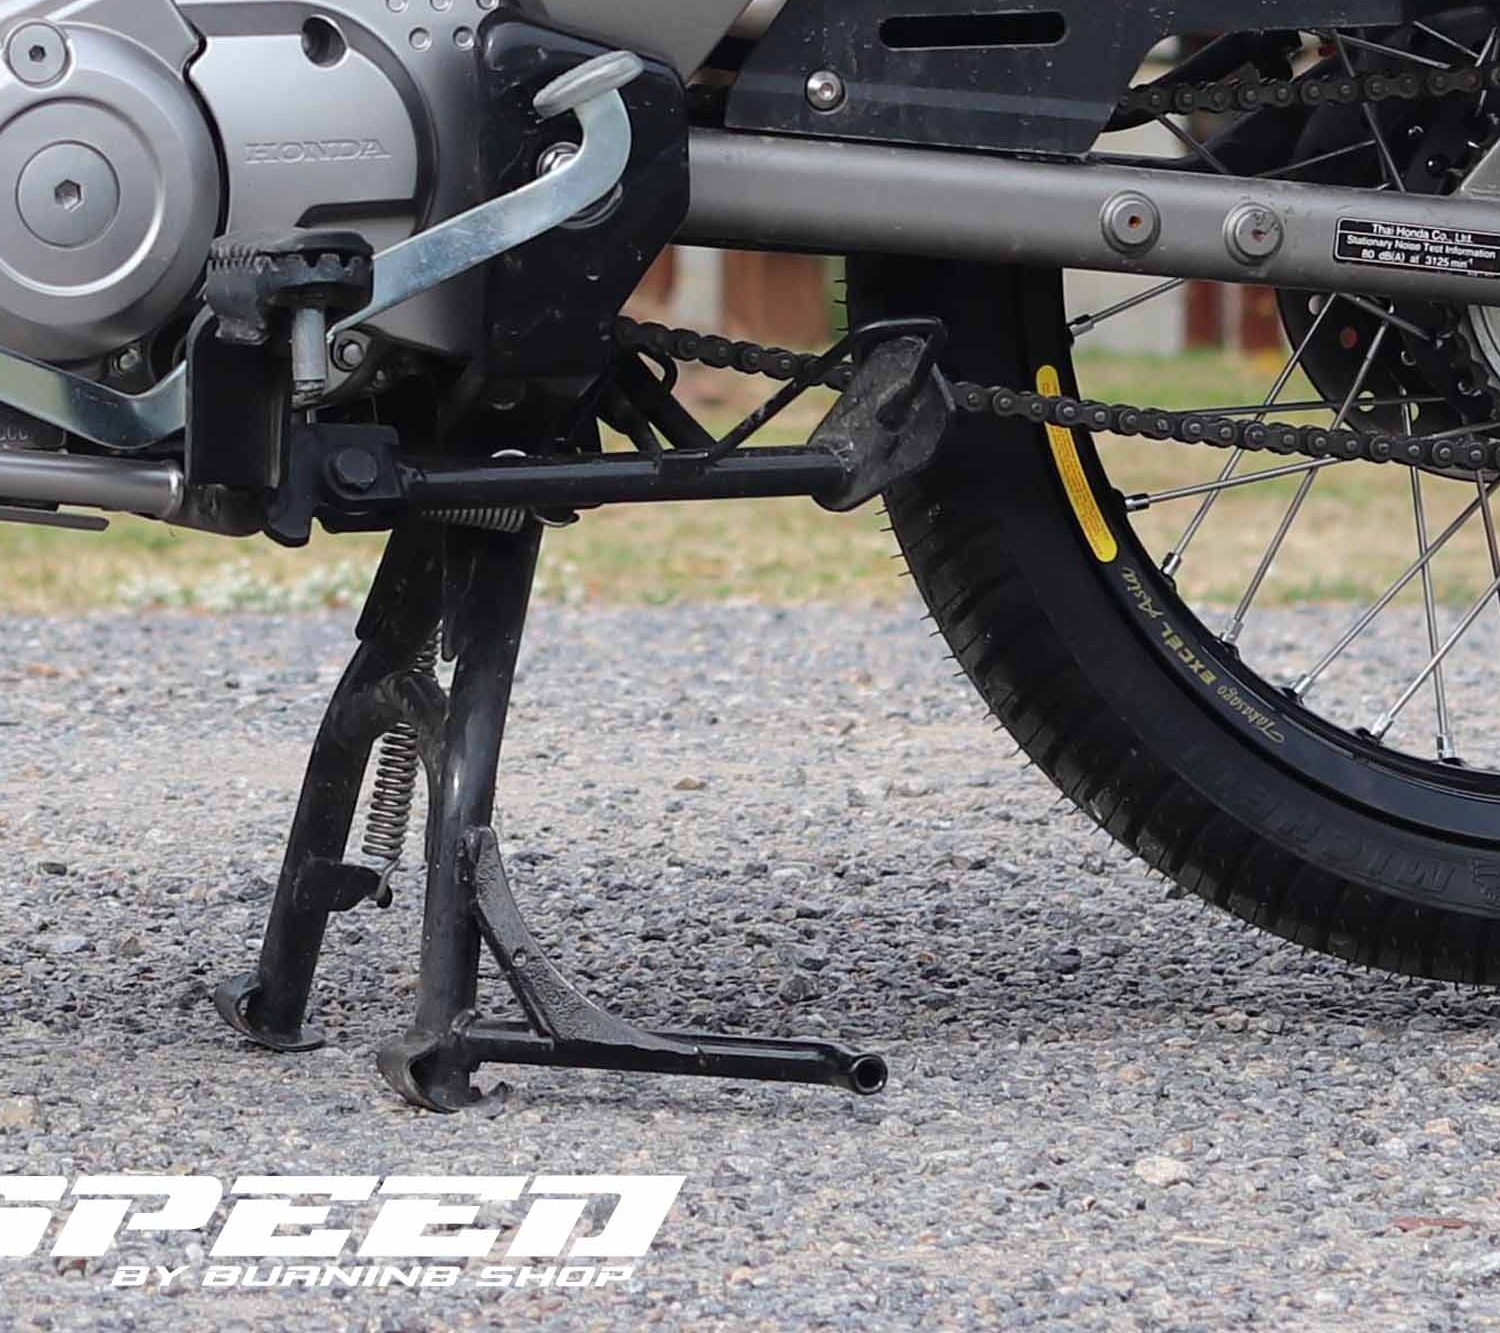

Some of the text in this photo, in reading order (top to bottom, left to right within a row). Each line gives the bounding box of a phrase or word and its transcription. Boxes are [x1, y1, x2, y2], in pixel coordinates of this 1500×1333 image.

[244, 137, 393, 165] HONDA
[1371, 223, 1395, 235] Thai
[1396, 226, 1430, 240] Honda
[1346, 234, 1497, 260] Stationary Noise Test Information
[1424, 255, 1450, 267] 3125
[1160, 621, 1217, 686] EXCEL
